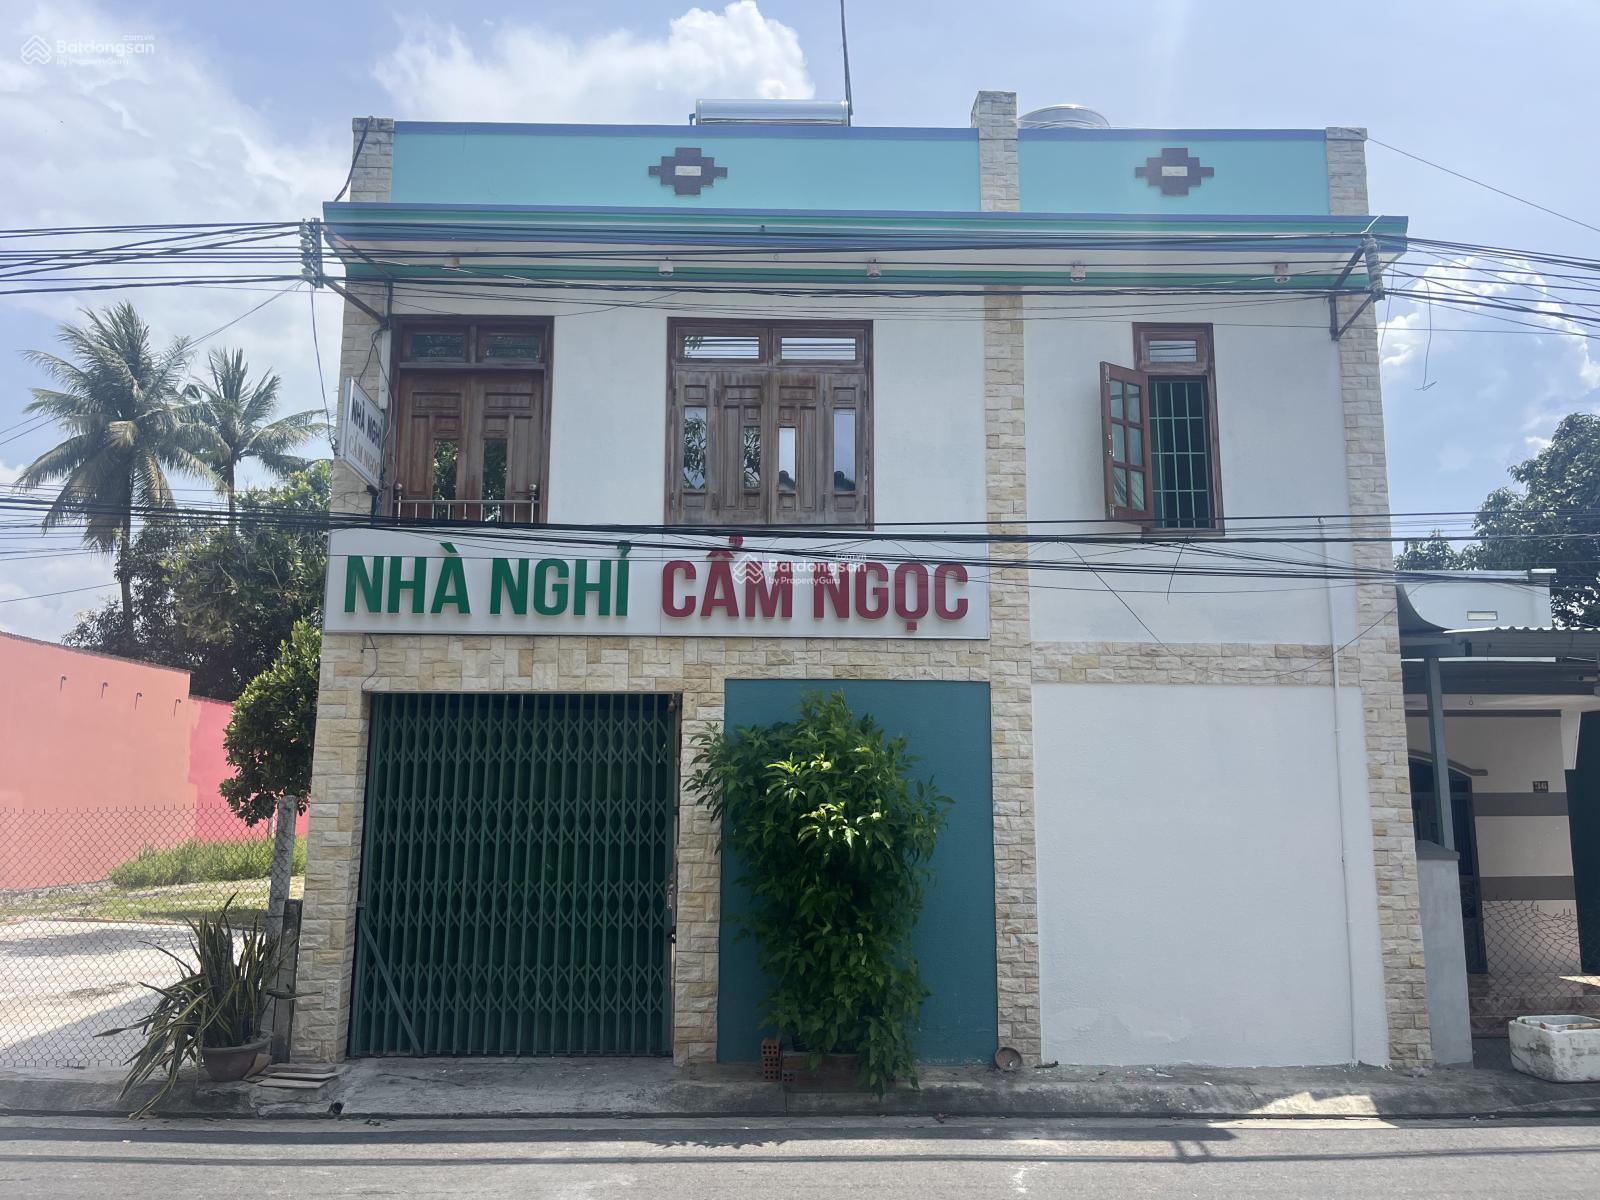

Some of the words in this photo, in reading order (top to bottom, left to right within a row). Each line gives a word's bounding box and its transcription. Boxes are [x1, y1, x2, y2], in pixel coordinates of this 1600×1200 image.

[344, 541, 471, 614] NHÀ
[490, 540, 630, 617] NGHỈ
[662, 535, 793, 618] CẨM
[813, 561, 969, 632] NGỌC
